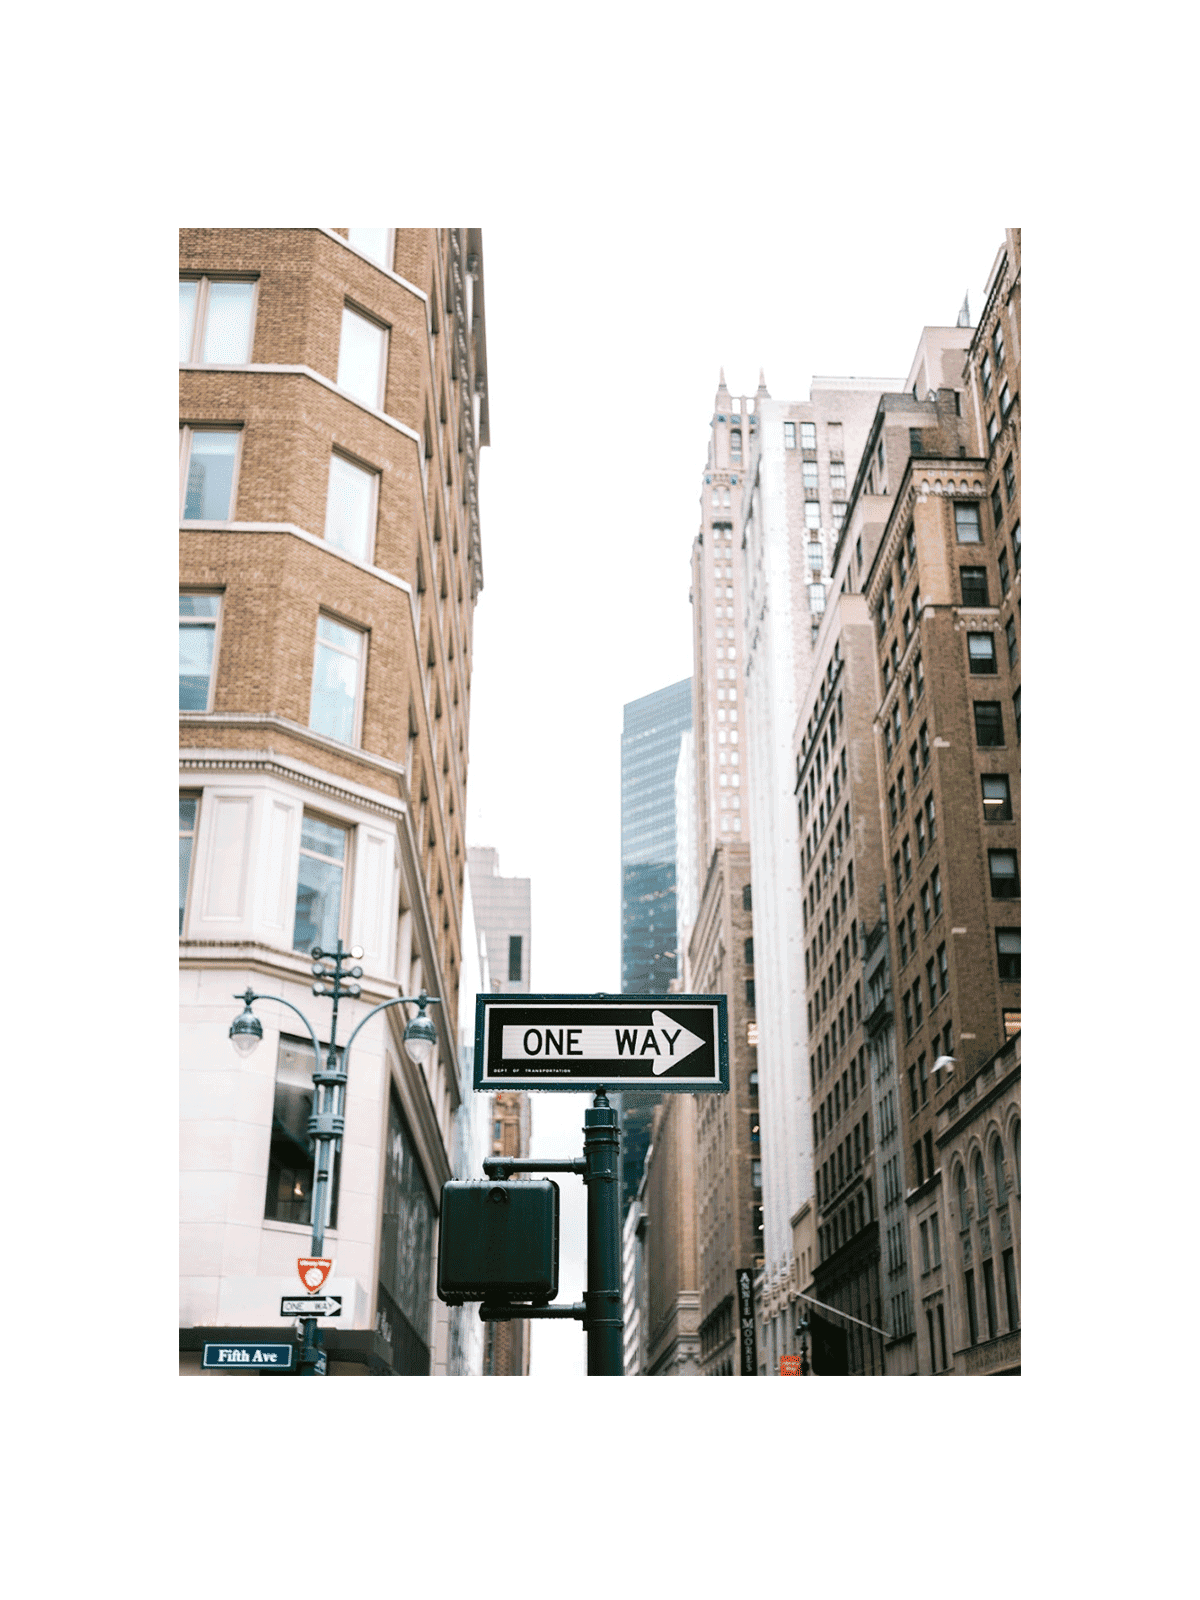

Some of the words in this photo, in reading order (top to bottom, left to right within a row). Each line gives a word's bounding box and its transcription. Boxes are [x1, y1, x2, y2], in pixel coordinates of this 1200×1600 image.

[523, 1028, 583, 1056] ONE
[615, 1028, 682, 1056] WAY
[740, 1272, 751, 1315] ANNIE
[285, 1302, 304, 1311] ONE
[315, 1302, 334, 1310] WAY
[217, 1348, 250, 1363] Fifth
[251, 1349, 278, 1363] Ave
